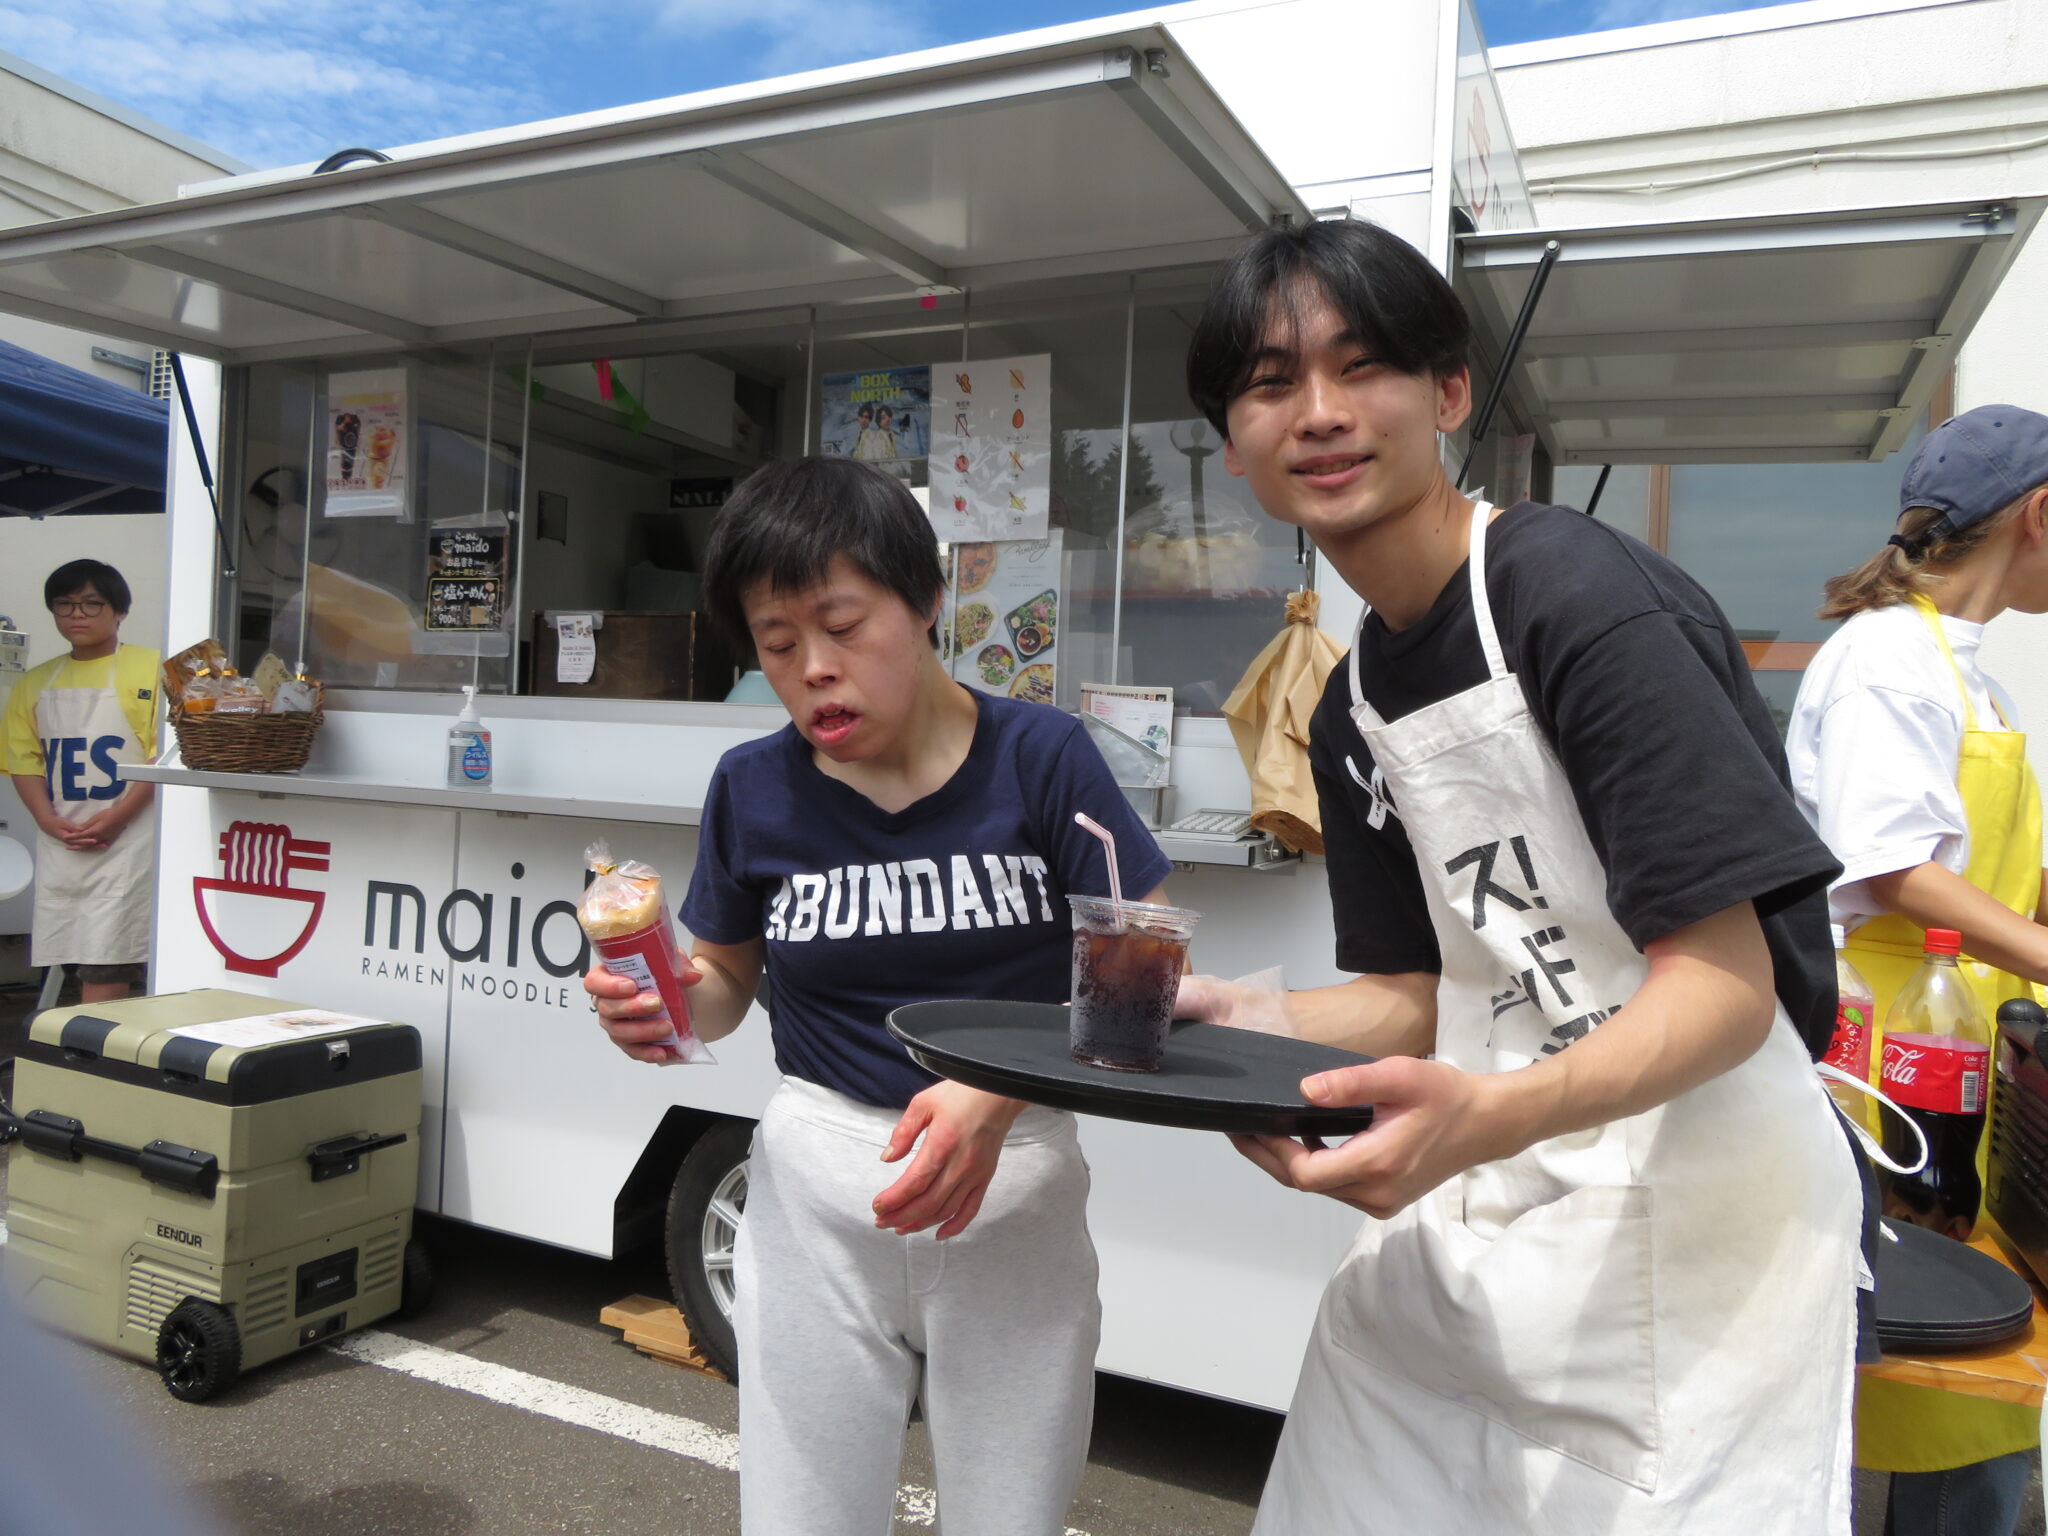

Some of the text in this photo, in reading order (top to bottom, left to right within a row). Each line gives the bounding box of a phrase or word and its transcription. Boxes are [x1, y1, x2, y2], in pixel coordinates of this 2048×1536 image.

[860, 373, 892, 388] BOX
[850, 387, 900, 403] NORTH
[454, 538, 490, 553] maido
[444, 584, 489, 601] 塩らーめん
[41, 735, 126, 801] YES
[765, 854, 1054, 942] ABUNDANT
[364, 862, 597, 978] maid
[361, 956, 444, 985] RAMEN
[461, 972, 569, 1008] NOODLE
[157, 1224, 203, 1248] EENOUR
